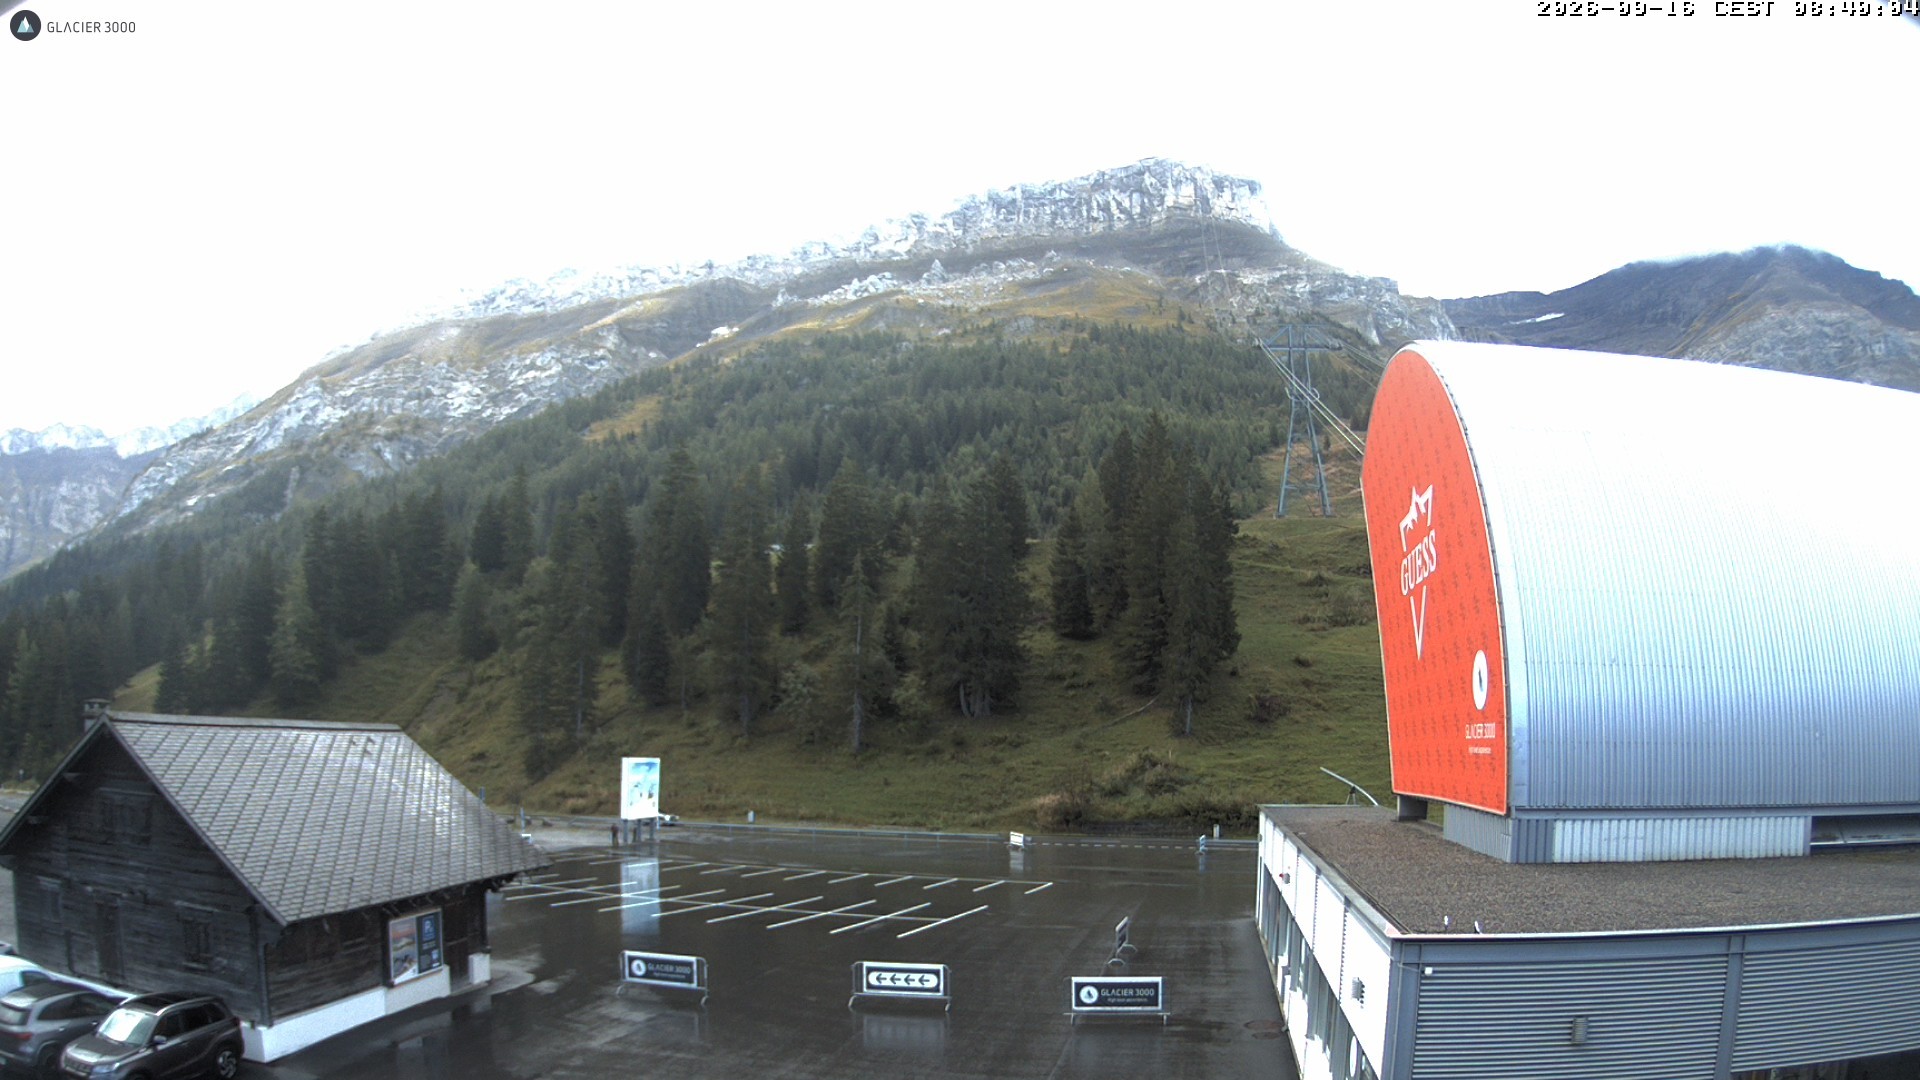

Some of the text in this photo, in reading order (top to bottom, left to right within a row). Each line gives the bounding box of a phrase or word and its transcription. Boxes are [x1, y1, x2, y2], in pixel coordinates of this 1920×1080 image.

[1400, 528, 1437, 596] GUESS
[1100, 988, 1155, 997] GLACIER 3000
